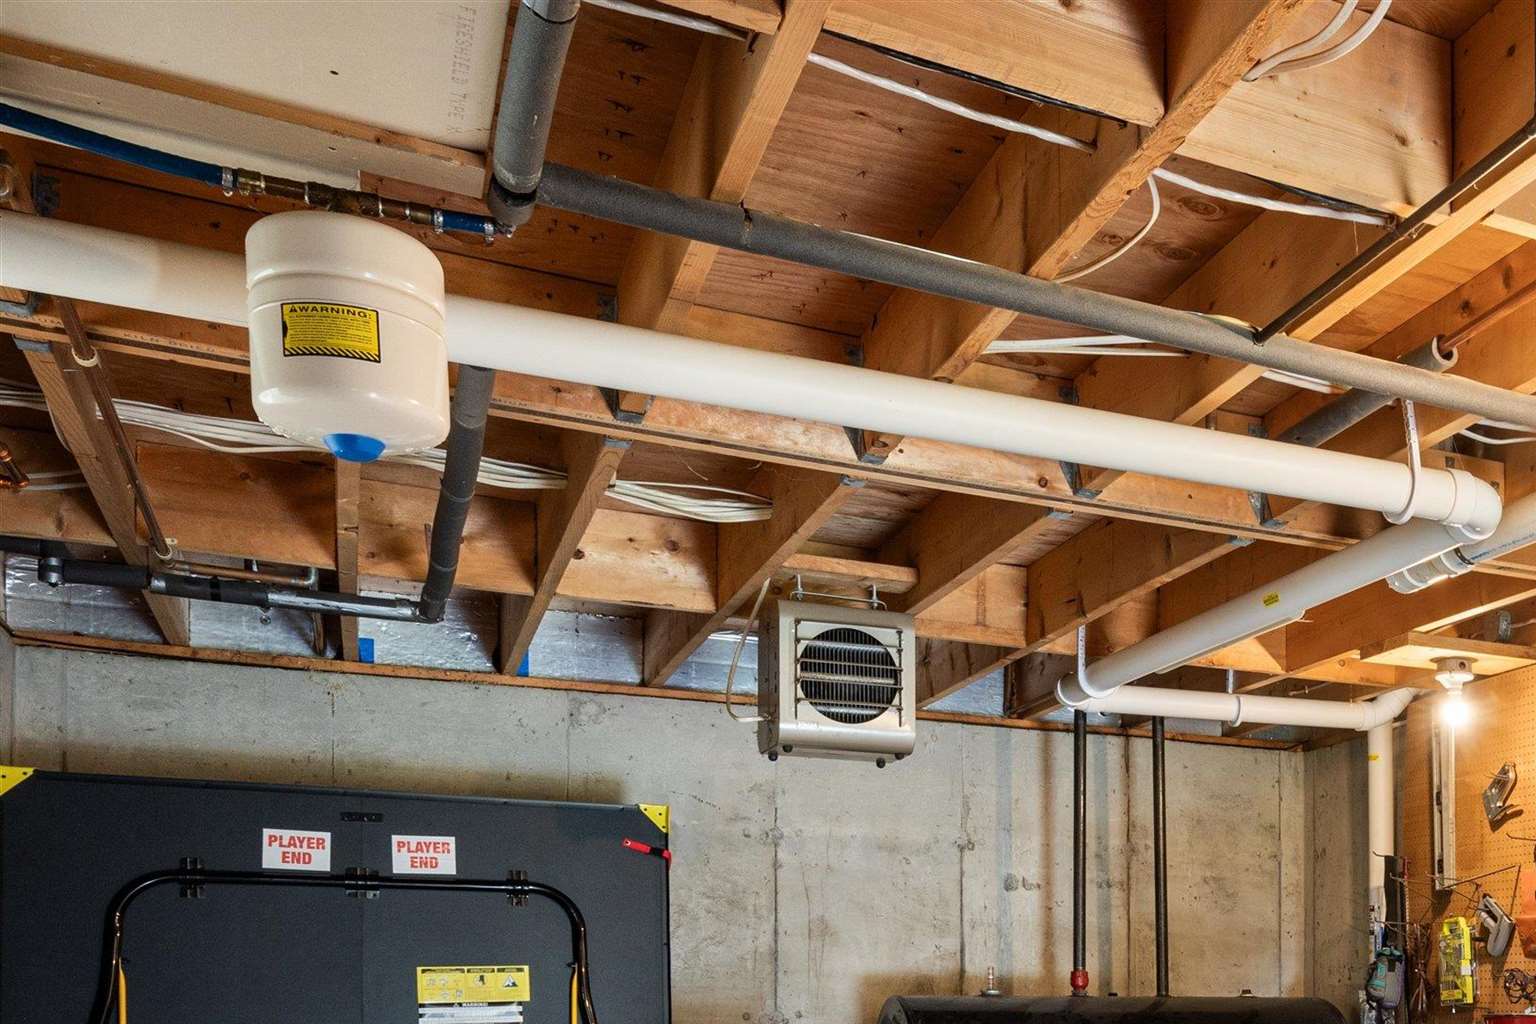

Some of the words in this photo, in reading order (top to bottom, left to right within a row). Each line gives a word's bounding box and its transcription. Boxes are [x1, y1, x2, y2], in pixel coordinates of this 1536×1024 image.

[268, 834, 326, 850] PLAYER
[397, 840, 451, 854] PLAYER
[281, 851, 312, 865] END
[410, 856, 439, 869] END
